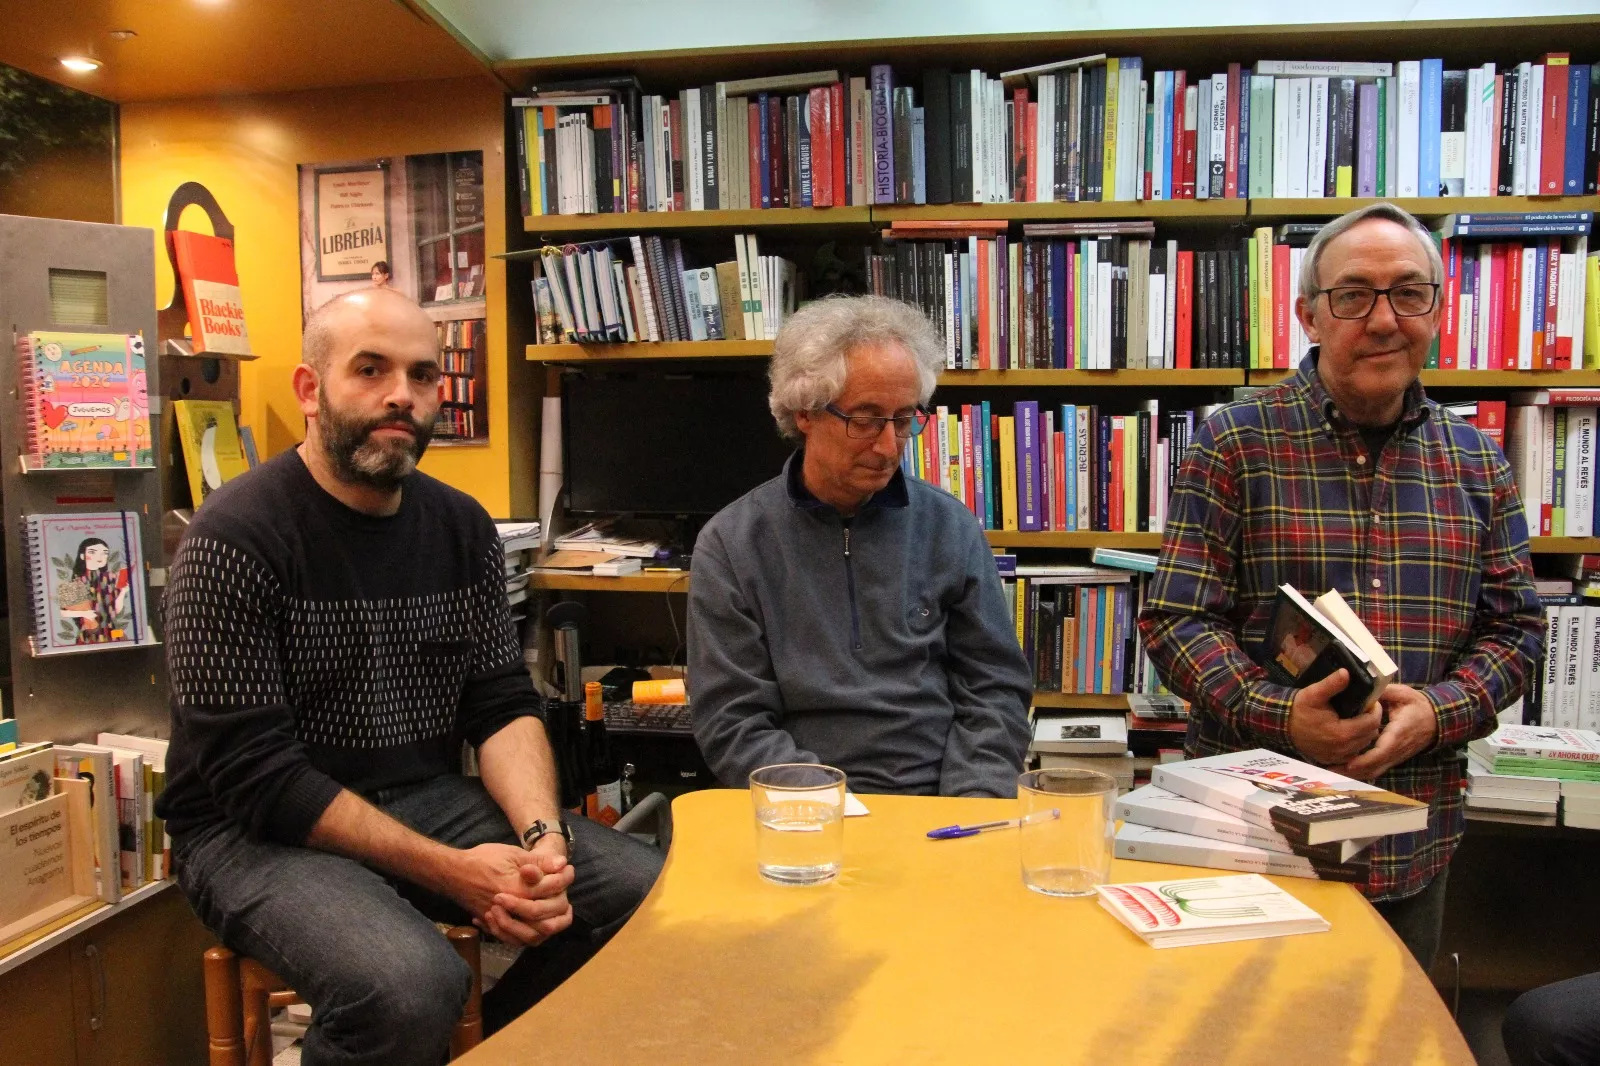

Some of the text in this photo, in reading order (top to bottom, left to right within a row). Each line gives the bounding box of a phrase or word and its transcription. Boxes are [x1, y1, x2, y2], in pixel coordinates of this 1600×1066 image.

[706, 130, 714, 153] PALABRA
[706, 166, 715, 179] BALA
[801, 144, 812, 196] ¡VIVA EL MAQUIS!
[322, 222, 384, 255] LIBRERÍA
[1551, 249, 1559, 262] LUZ
[1548, 267, 1558, 307] TAQUÍGRAFA
[199, 298, 244, 321] Blackie
[203, 316, 242, 337] Books
[60, 360, 124, 375] AGENDA
[71, 375, 111, 388] 2026
[71, 406, 111, 414] JUGUEMOS
[1580, 418, 1590, 489] EL MUNDO AL REVÉS
[1571, 617, 1579, 625] EL
[1570, 627, 1579, 649] MUNDO
[1548, 616, 1559, 684] ROMA OSCURA
[1569, 653, 1577, 662] AL
[1592, 632, 1600, 673] PURGATORIO
[1557, 752, 1580, 760] AHORA
[1581, 752, 1599, 761] QUÉ?
[10, 809, 61, 837] El espíritu de
[15, 823, 62, 848] los tiempos
